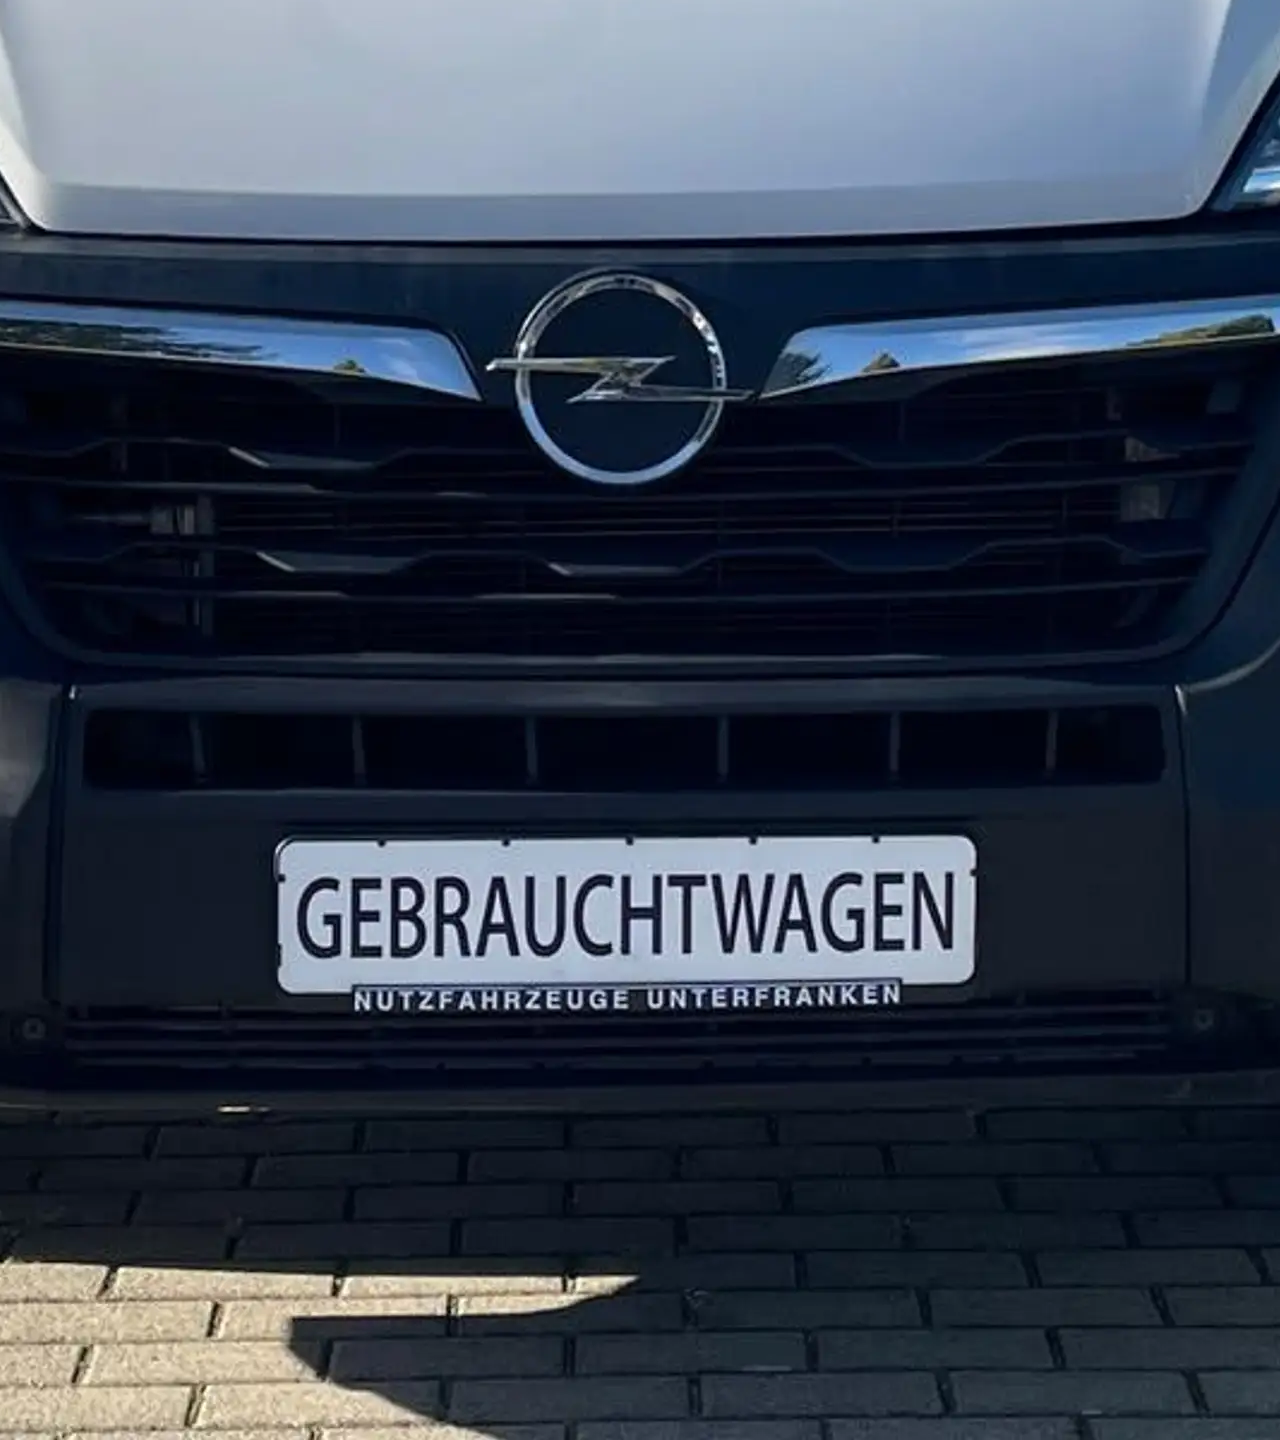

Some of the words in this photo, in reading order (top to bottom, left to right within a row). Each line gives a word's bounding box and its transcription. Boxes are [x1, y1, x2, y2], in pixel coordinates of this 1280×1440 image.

[296, 871, 954, 959] GEBRAUCHTWAGEN
[353, 988, 630, 1012] NUTZFAHRZEUGE
[646, 984, 902, 1010] UNTERFRANKEN
